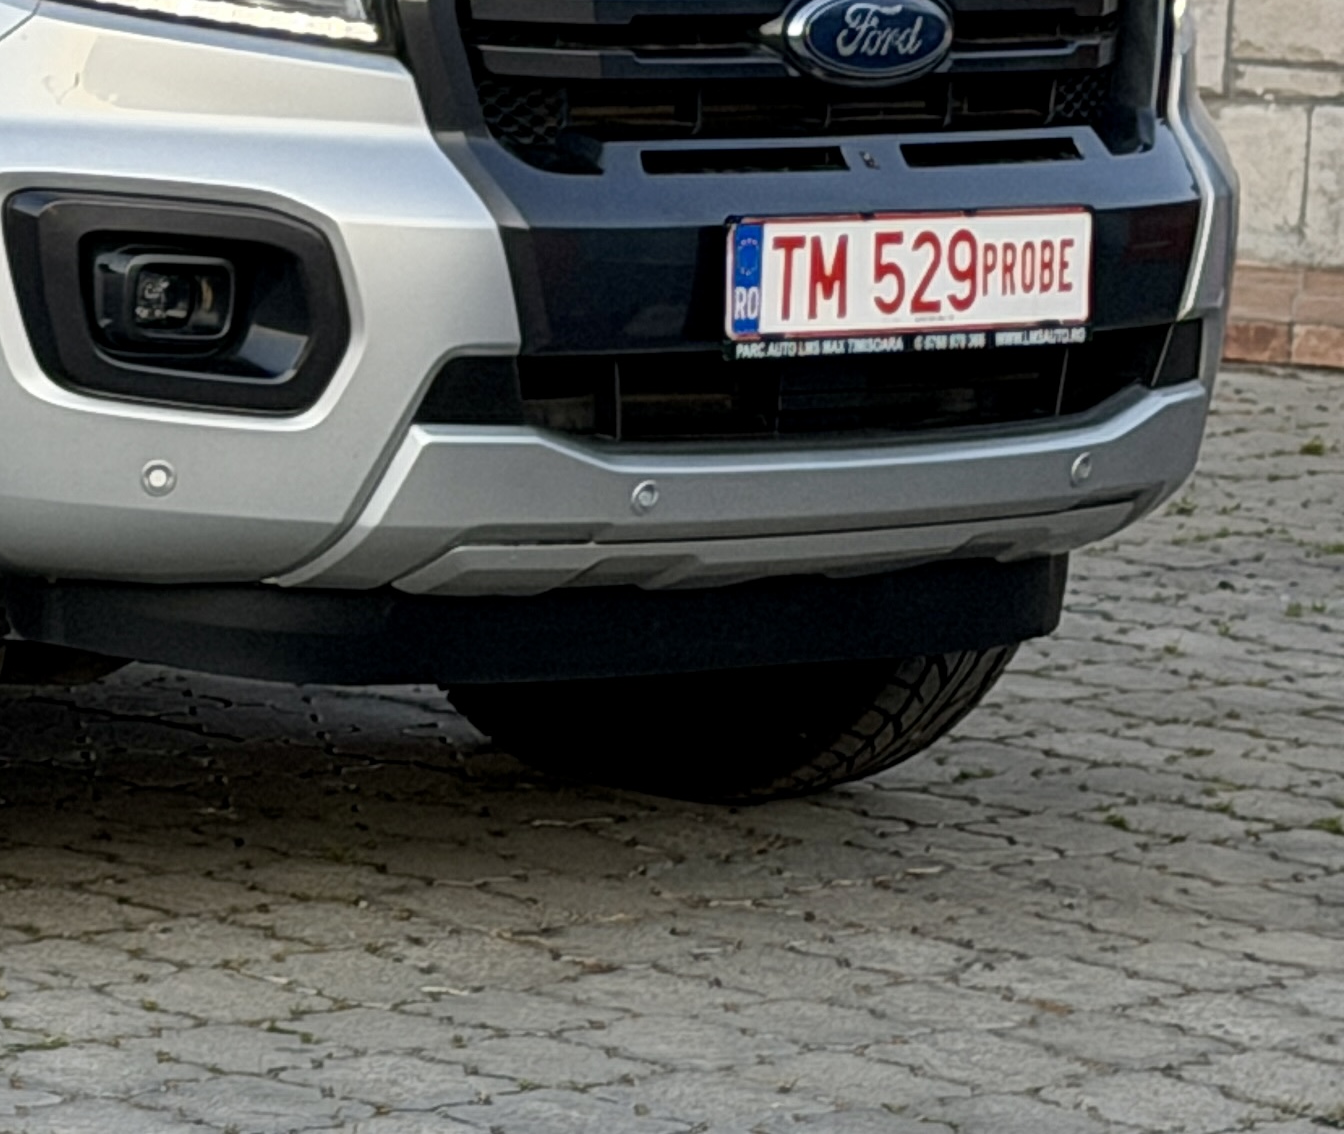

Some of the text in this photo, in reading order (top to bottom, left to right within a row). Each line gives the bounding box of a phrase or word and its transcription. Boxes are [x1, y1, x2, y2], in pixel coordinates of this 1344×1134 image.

[836, 2, 923, 57] Ford
[773, 229, 1074, 320] TM 529 PROBE
[734, 286, 759, 321] RO
[736, 342, 765, 359] PARC
[767, 340, 797, 357] AUTO
